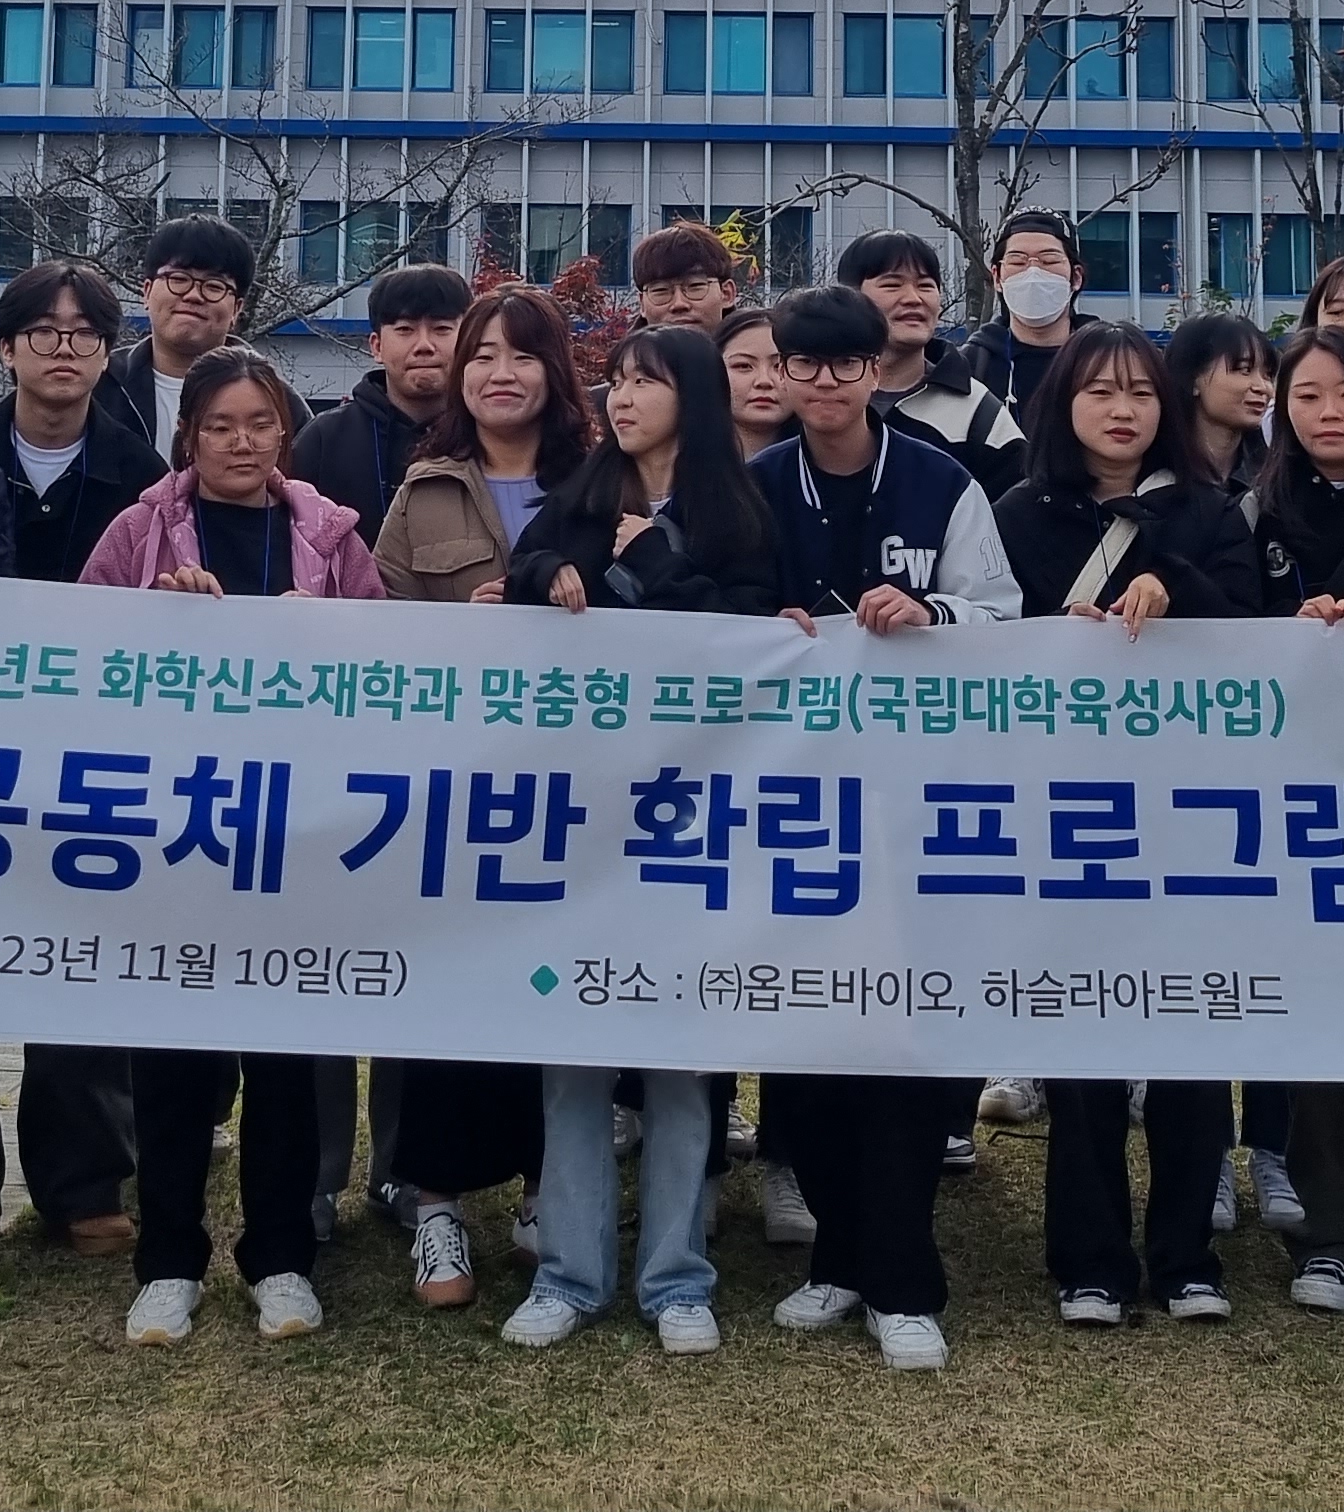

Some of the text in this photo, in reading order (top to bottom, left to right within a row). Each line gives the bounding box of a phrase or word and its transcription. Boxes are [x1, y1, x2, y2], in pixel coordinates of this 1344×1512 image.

[880, 534, 938, 590] GW
[97, 648, 464, 723] 화학신소재학과
[481, 666, 630, 730] 맞춤형
[649, 673, 1288, 739] 프로그램(국립대학육성사업)
[337, 767, 588, 903] 기반
[622, 765, 863, 917] 확립
[117, 940, 219, 991] 11월
[233, 945, 410, 999] 10일(금)
[572, 956, 660, 1007] 장소
[979, 967, 1290, 1022] 하슬라아트월드
